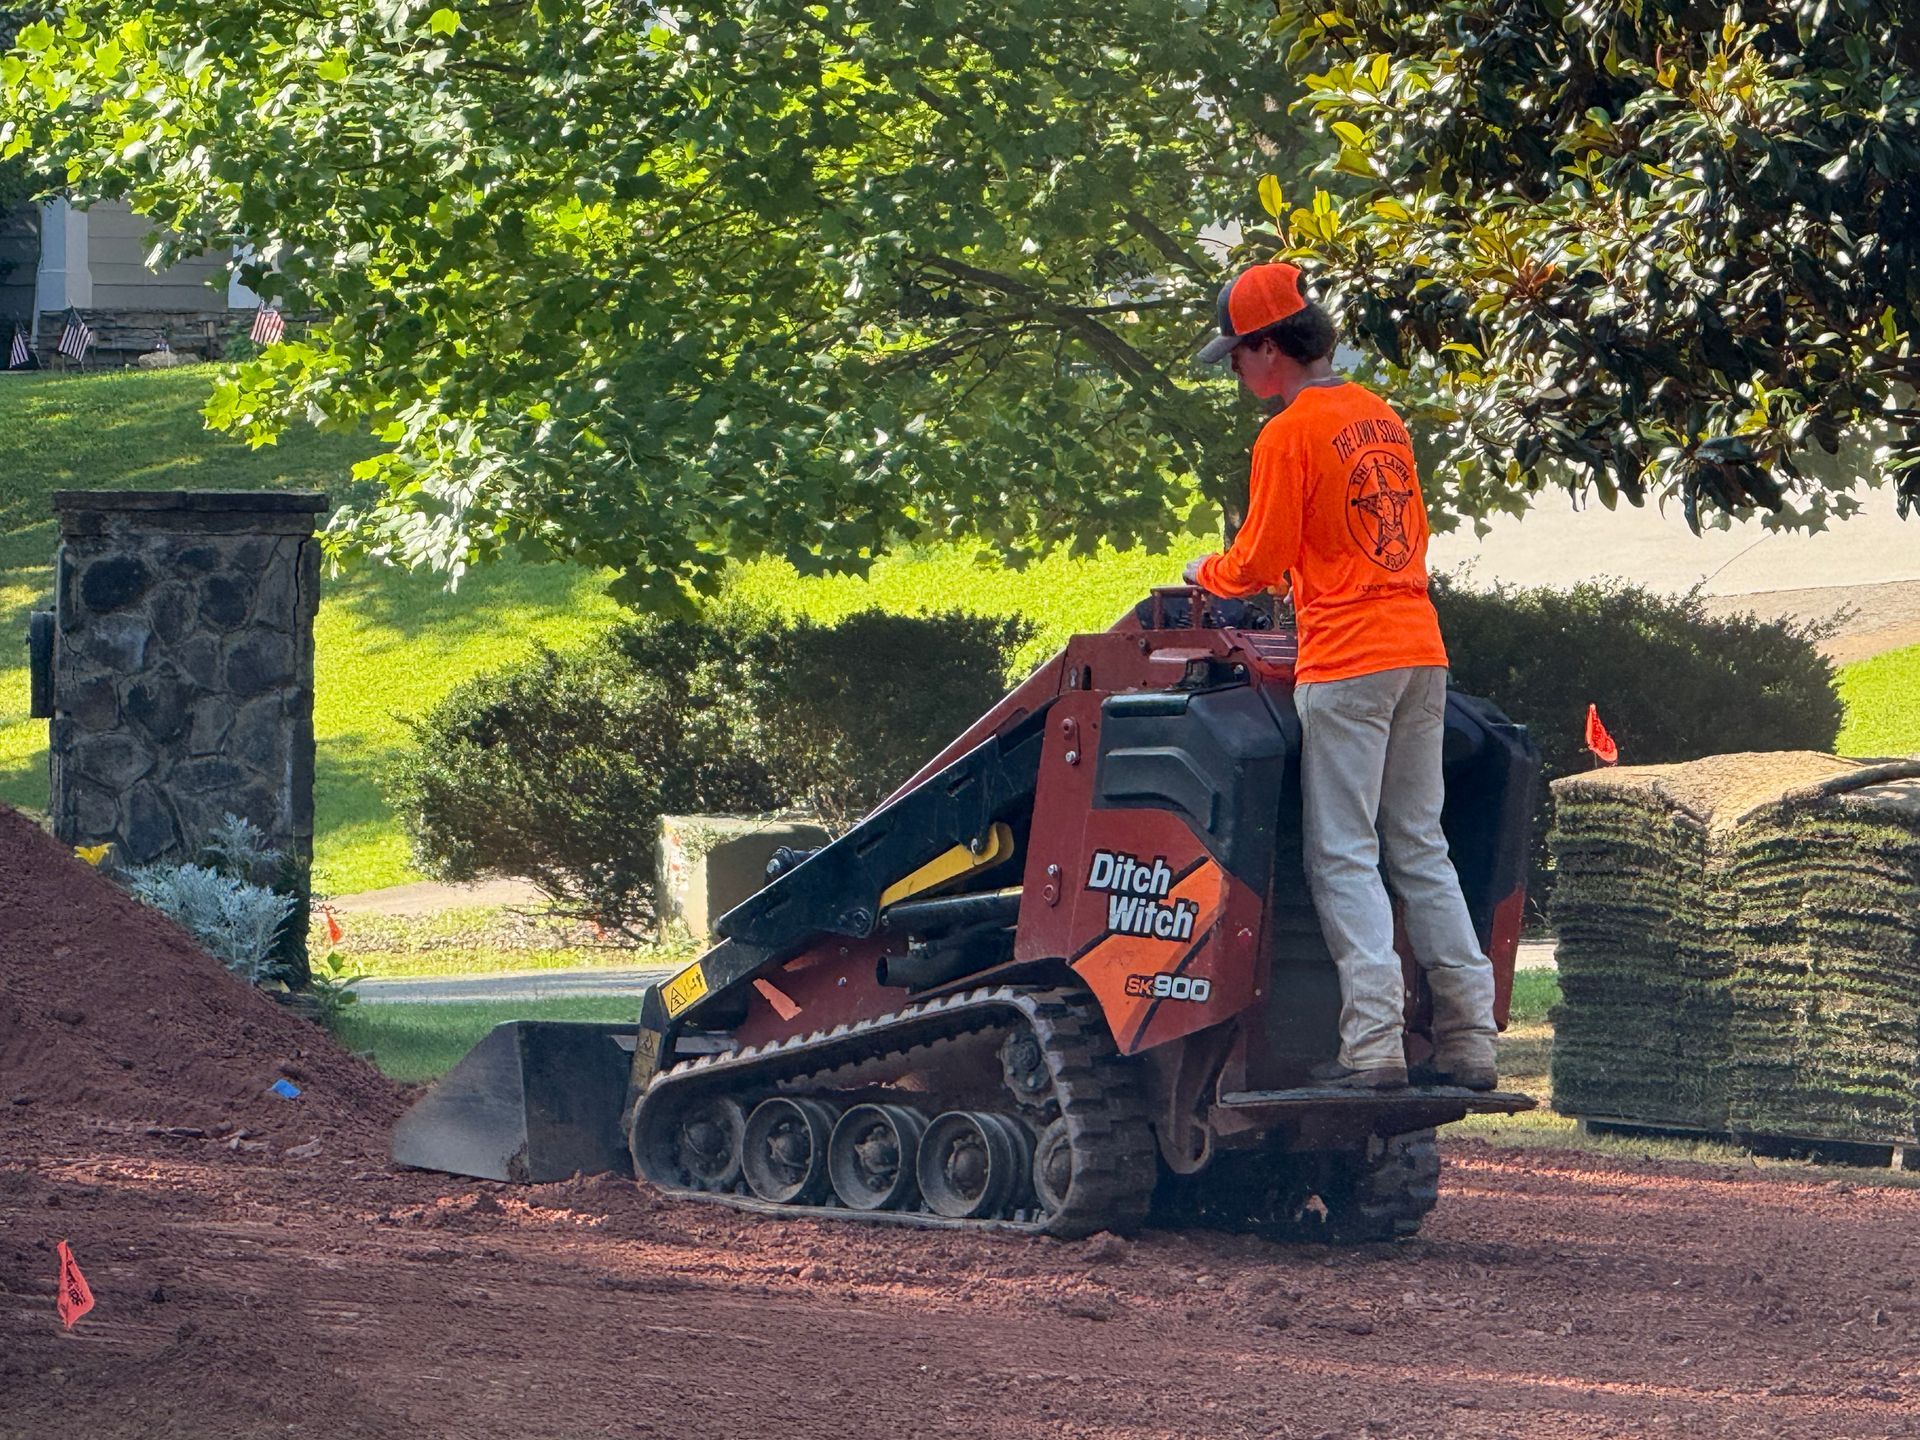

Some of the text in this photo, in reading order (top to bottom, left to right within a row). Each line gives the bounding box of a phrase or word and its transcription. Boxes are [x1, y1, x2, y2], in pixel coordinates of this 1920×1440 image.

[1332, 427, 1355, 464] THE
[1349, 419, 1379, 448] LAWN
[1088, 852, 1171, 895] Ditch
[1108, 894, 1194, 938] Witch
[1126, 975, 1210, 1001] SK900
